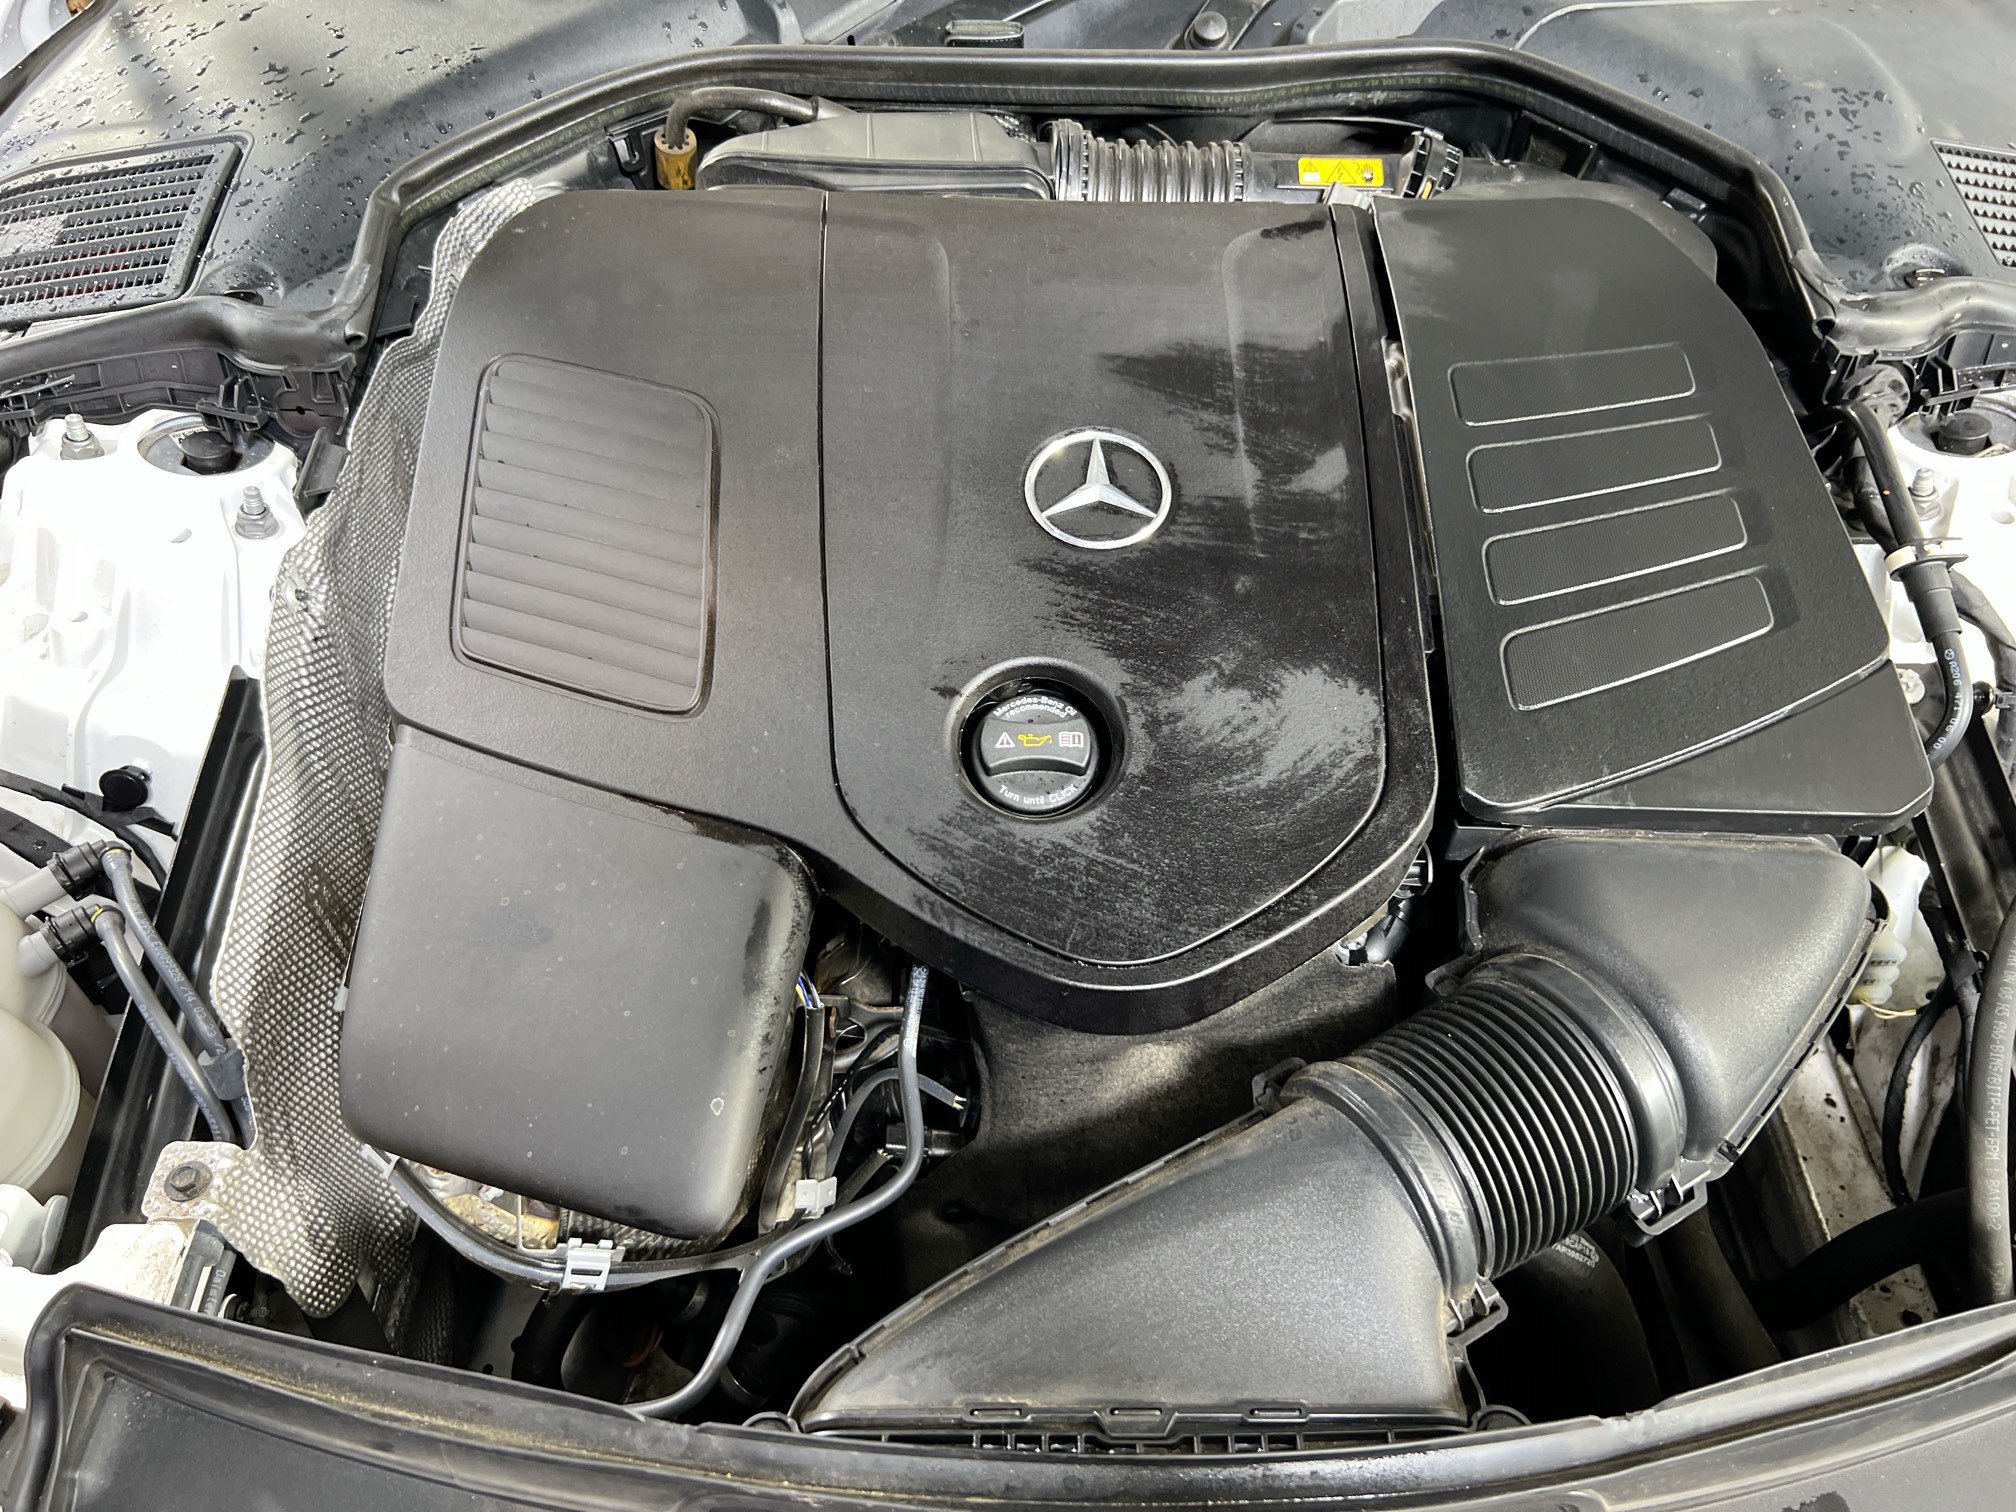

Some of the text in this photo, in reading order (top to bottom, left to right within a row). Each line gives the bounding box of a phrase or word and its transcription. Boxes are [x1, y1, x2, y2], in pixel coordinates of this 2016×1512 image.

[1949, 661, 1963, 685] A206
[993, 695, 1077, 717] Mercedes-Benz Oil
[1005, 703, 1067, 718] recommended
[1933, 736, 1946, 749] 00
[1000, 783, 1077, 804] Turn until CLICK
